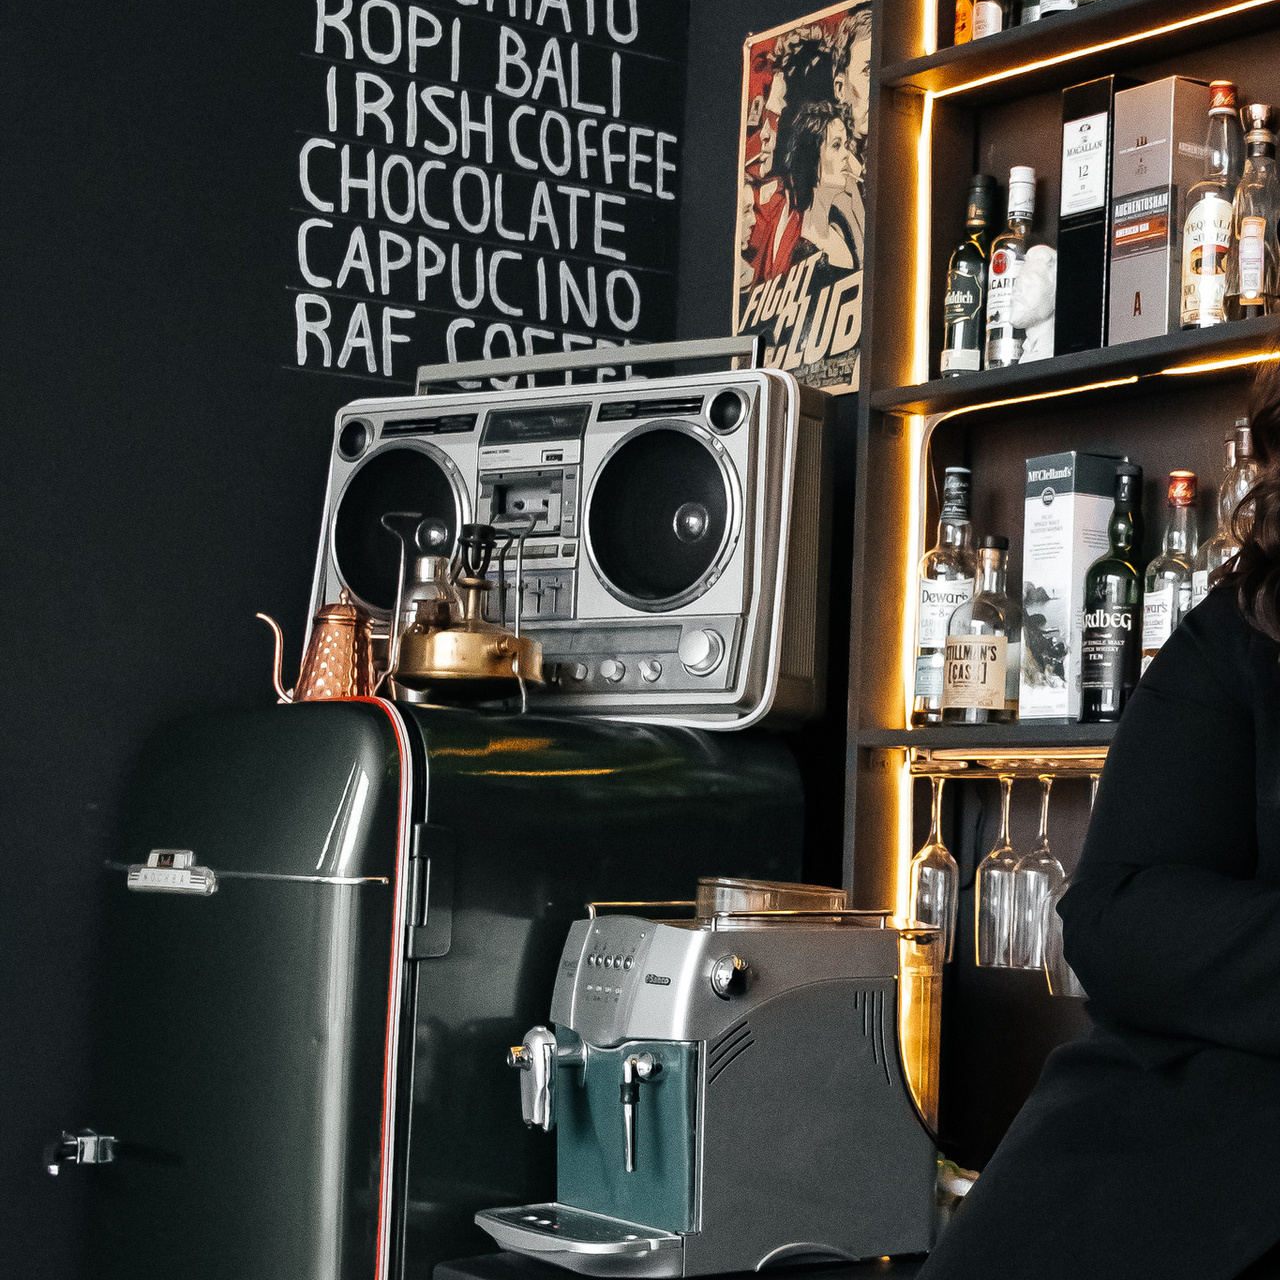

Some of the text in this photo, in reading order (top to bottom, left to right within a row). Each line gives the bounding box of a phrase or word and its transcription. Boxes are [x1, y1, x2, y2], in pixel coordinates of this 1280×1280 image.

[496, 24, 621, 118] BALI
[326, 65, 678, 200] IRISH COFFEE
[1066, 139, 1104, 158] MACALLAN
[1078, 164, 1089, 178] 12
[299, 137, 627, 261] CHOCOLATE
[297, 218, 641, 332] CAPPUCINO
[738, 251, 824, 333] FIGHT
[1133, 291, 1142, 317] A
[295, 293, 416, 377] RAF
[766, 269, 864, 372] CLUB
[921, 589, 969, 605] Dewar's
[1089, 653, 1103, 661] TEN
